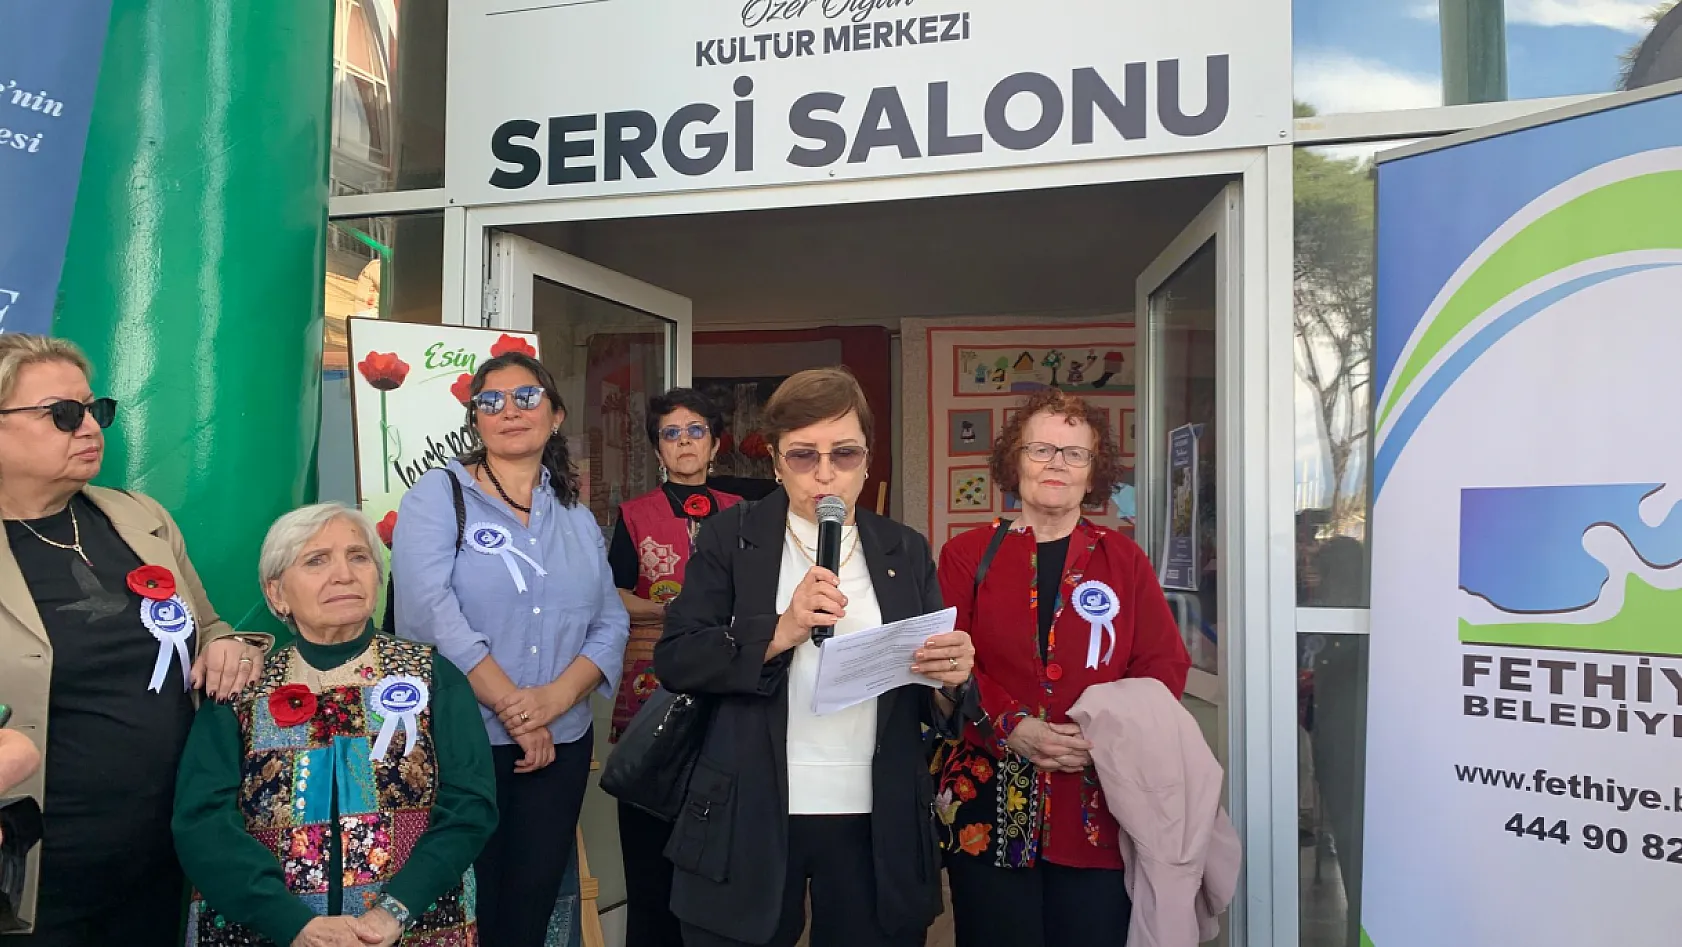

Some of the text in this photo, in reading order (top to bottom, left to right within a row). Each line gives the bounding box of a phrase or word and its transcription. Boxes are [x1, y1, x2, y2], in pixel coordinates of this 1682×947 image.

[696, 12, 970, 67] KÜLTÜR MERKEZİ
[0, 80, 64, 117] ’nin
[488, 54, 1230, 190] SERGİ SALONU
[423, 341, 477, 375] Esin
[1504, 812, 1682, 864] 444 90 82
